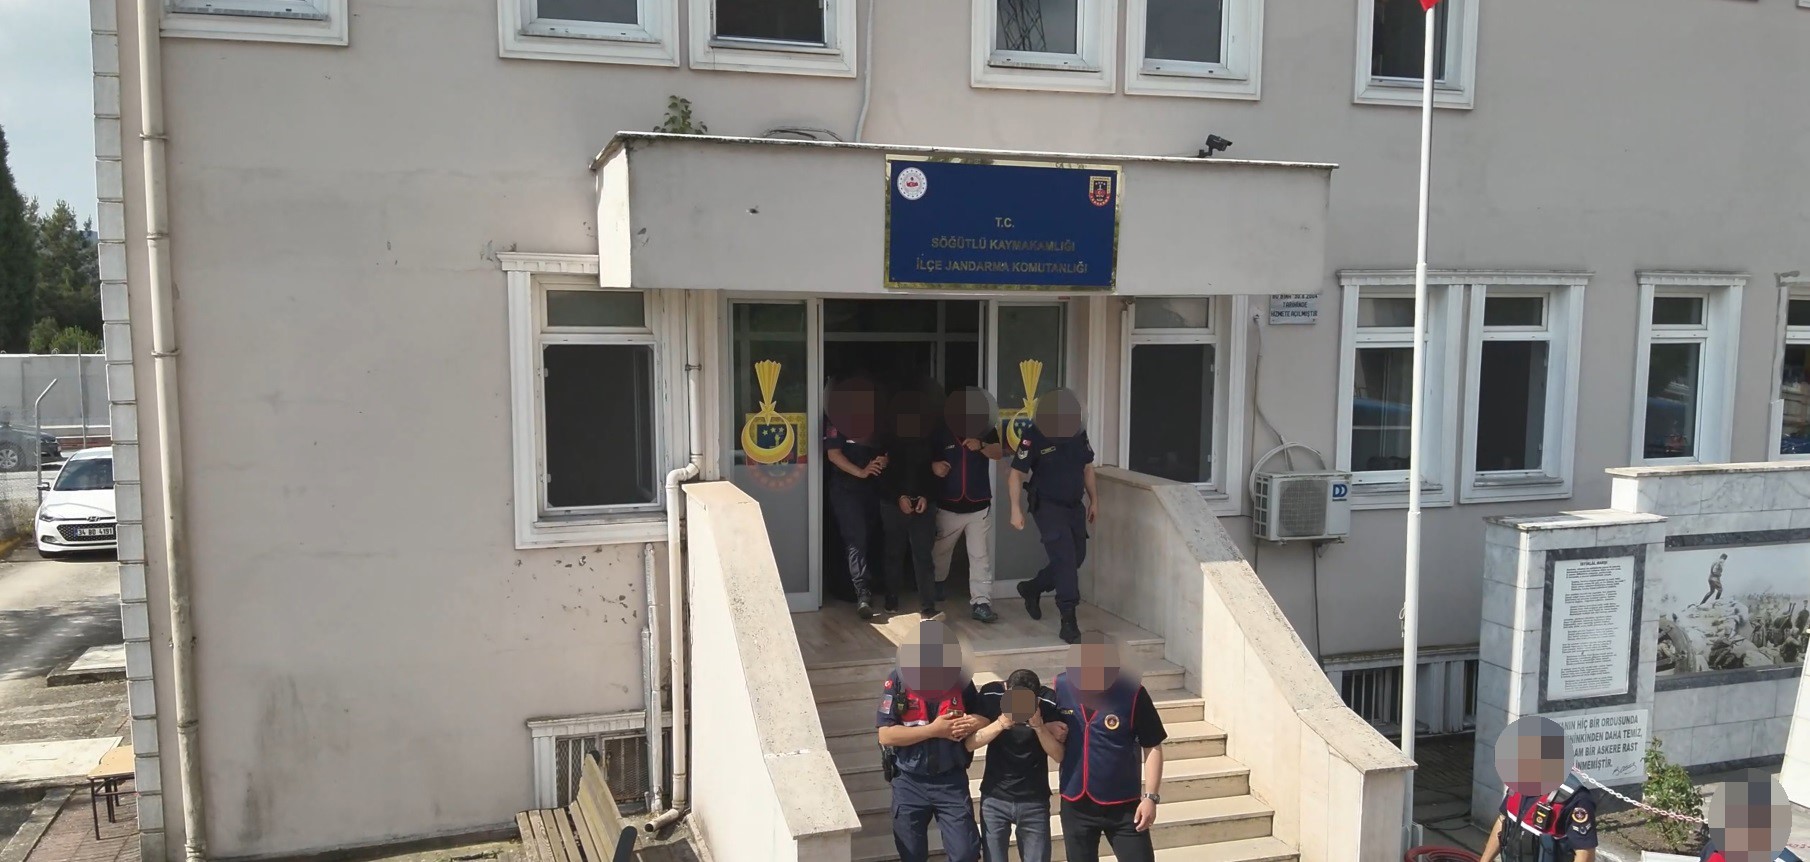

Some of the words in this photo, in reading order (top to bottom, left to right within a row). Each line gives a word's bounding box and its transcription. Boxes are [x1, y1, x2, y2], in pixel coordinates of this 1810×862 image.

[995, 217, 1015, 228] T.C.
[931, 235, 986, 249] SÖĞÜTLÜ
[989, 239, 1075, 252] KAYMAKAMLIĞI
[916, 256, 942, 272] İLÇE
[945, 260, 1009, 272] JANDARMA
[1012, 260, 1088, 274] KOMUTANLIĞI
[1576, 717, 1588, 731] HİÇ
[1589, 716, 1600, 729] BİR
[1601, 715, 1638, 727] ORDUSUNDA
[1604, 730, 1622, 741] DAHA
[1584, 744, 1596, 757] BİR
[1597, 744, 1621, 756] ASKERE
[1622, 742, 1638, 753] RAST
